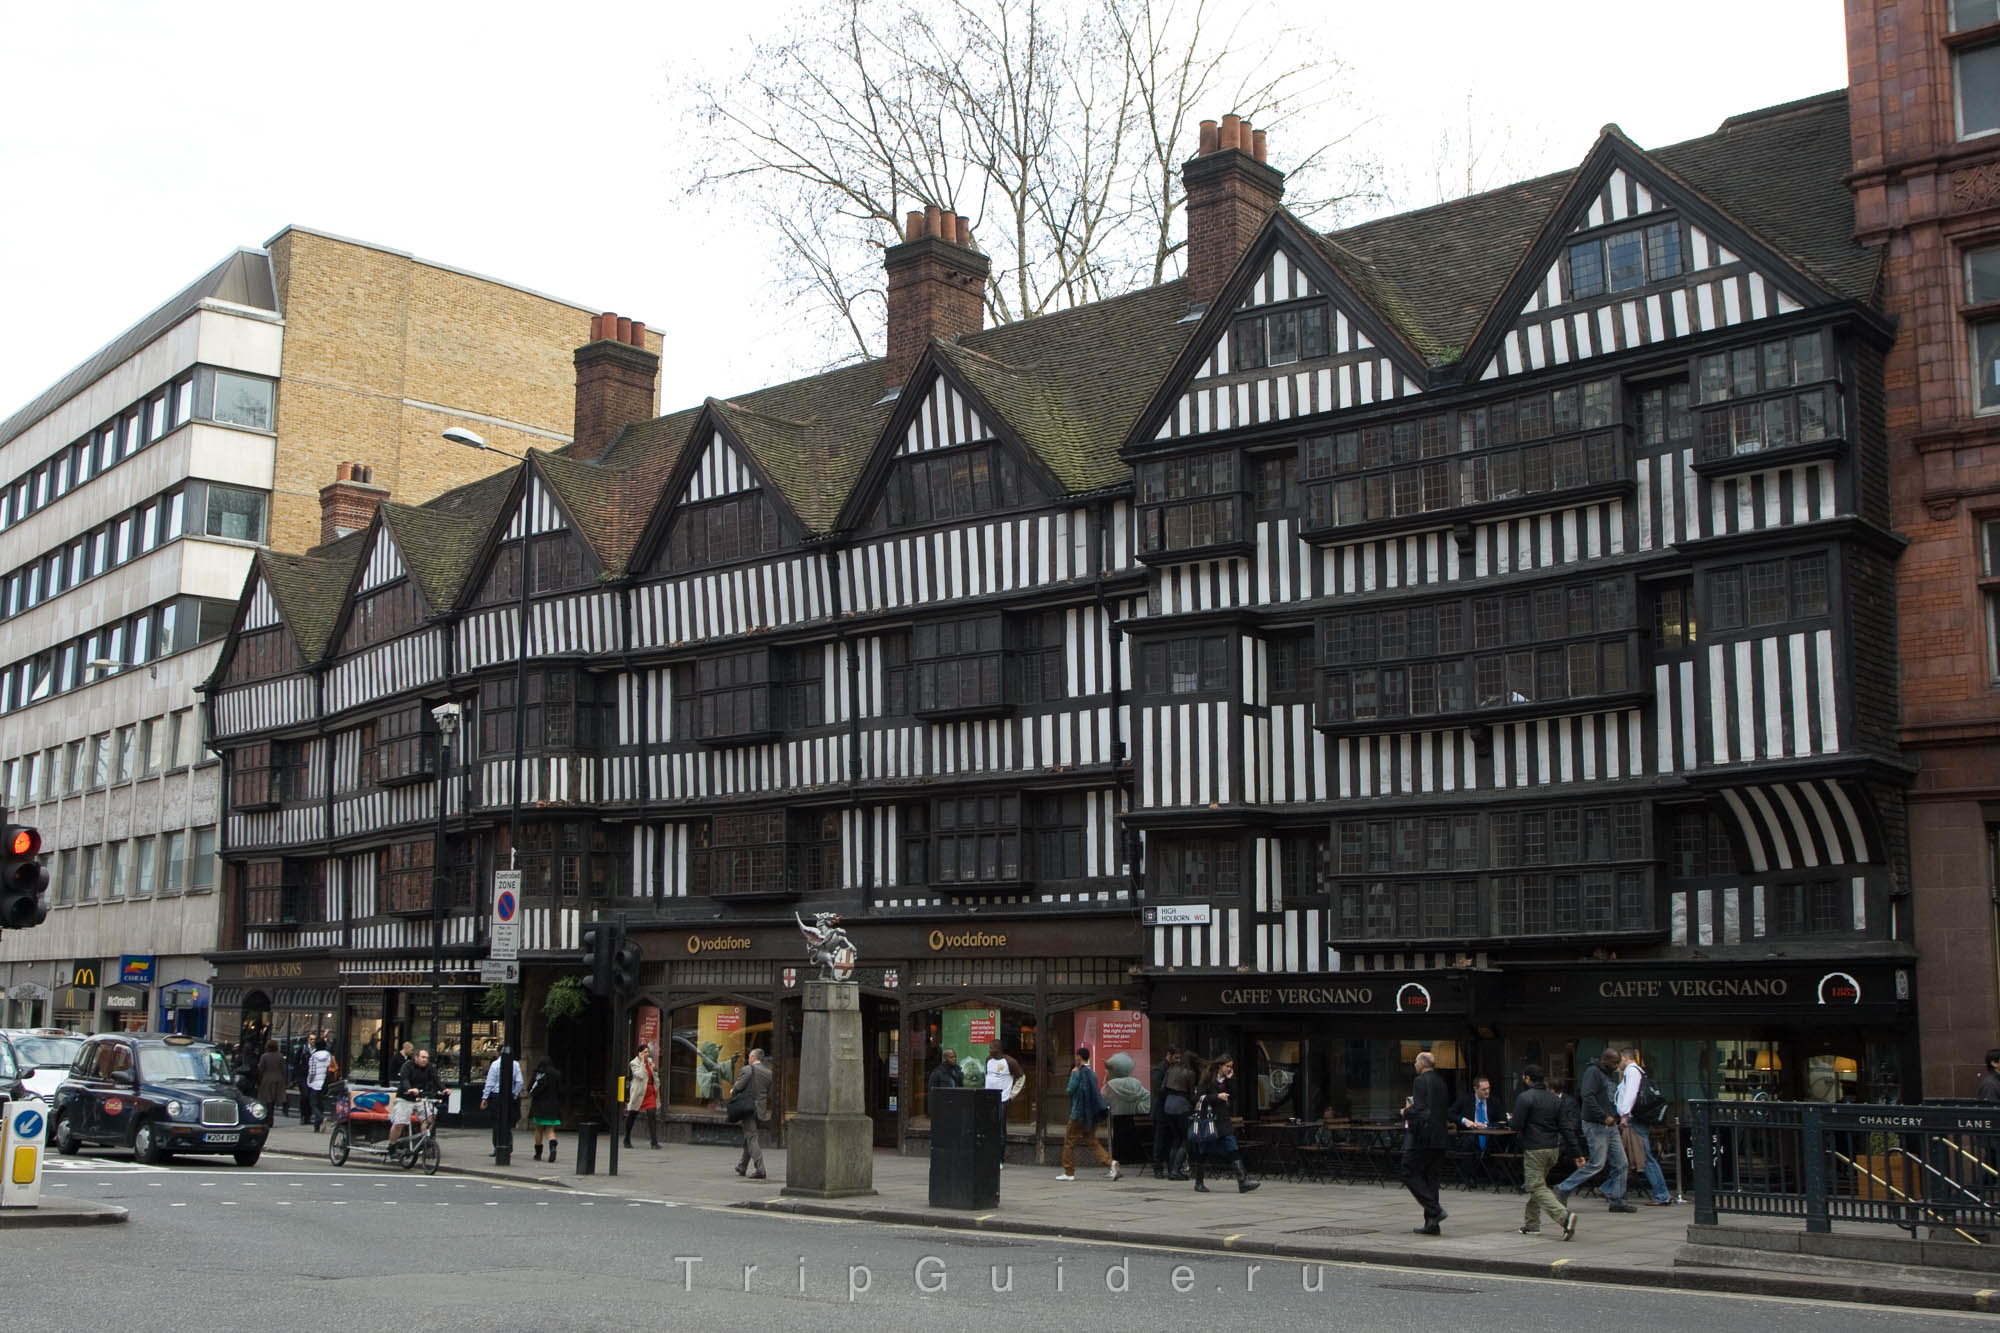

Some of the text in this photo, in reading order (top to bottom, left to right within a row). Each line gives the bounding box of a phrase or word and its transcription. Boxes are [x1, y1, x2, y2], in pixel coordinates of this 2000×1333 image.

[499, 881, 516, 889] ZONE
[701, 936, 751, 950] vodafone
[945, 931, 1007, 947] vodafone
[273, 963, 280, 977] &
[281, 962, 303, 977] SONS
[368, 972, 423, 986] SANFORD
[1600, 979, 1788, 998] CAFFE' VERGNANO
[107, 995, 137, 1007] McDonald's
[1220, 988, 1372, 1004] CAFFE' VERGNANO
[1859, 1116, 1992, 1128] CHANCERY LANE
